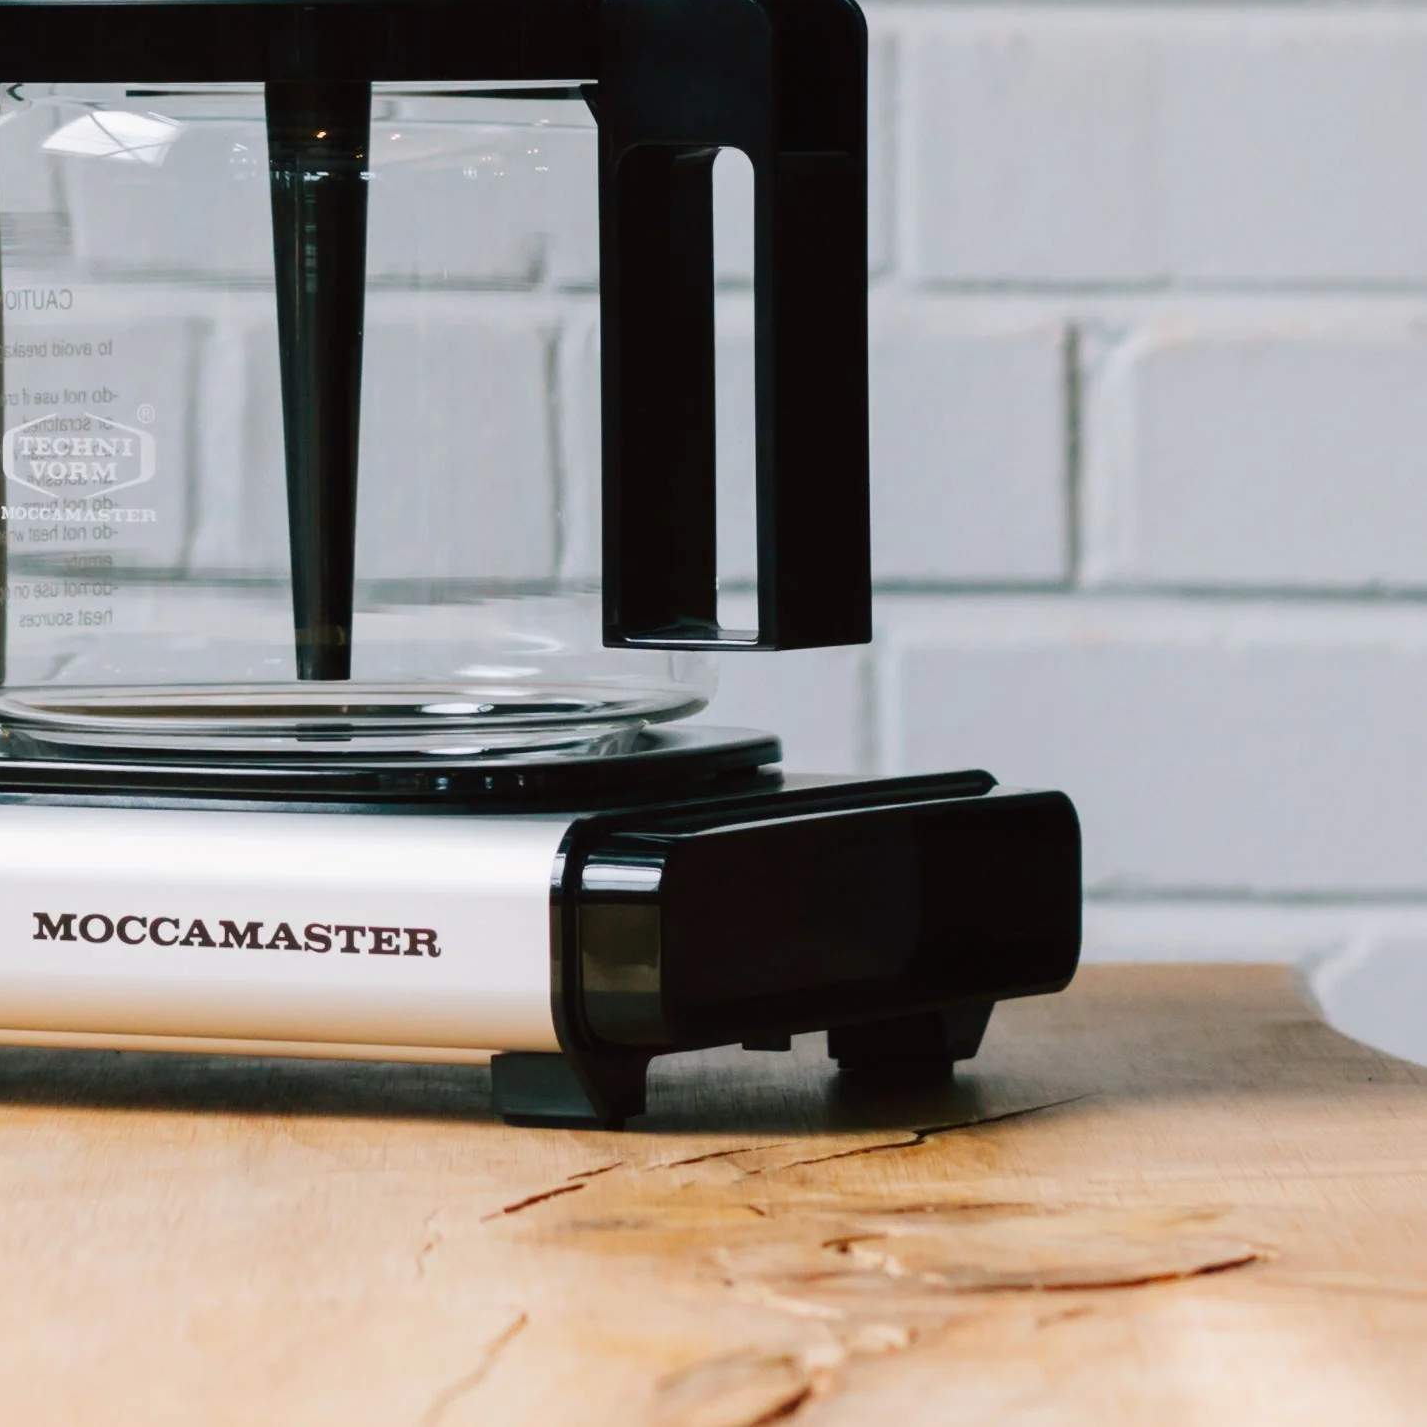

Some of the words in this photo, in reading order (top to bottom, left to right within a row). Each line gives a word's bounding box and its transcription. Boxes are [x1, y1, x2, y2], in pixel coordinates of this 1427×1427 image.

[18, 436, 133, 457] TECHNI
[30, 461, 118, 481] VORM
[0, 506, 157, 522] MOCCAMASTER
[32, 911, 442, 959] MOCCAMASTER
